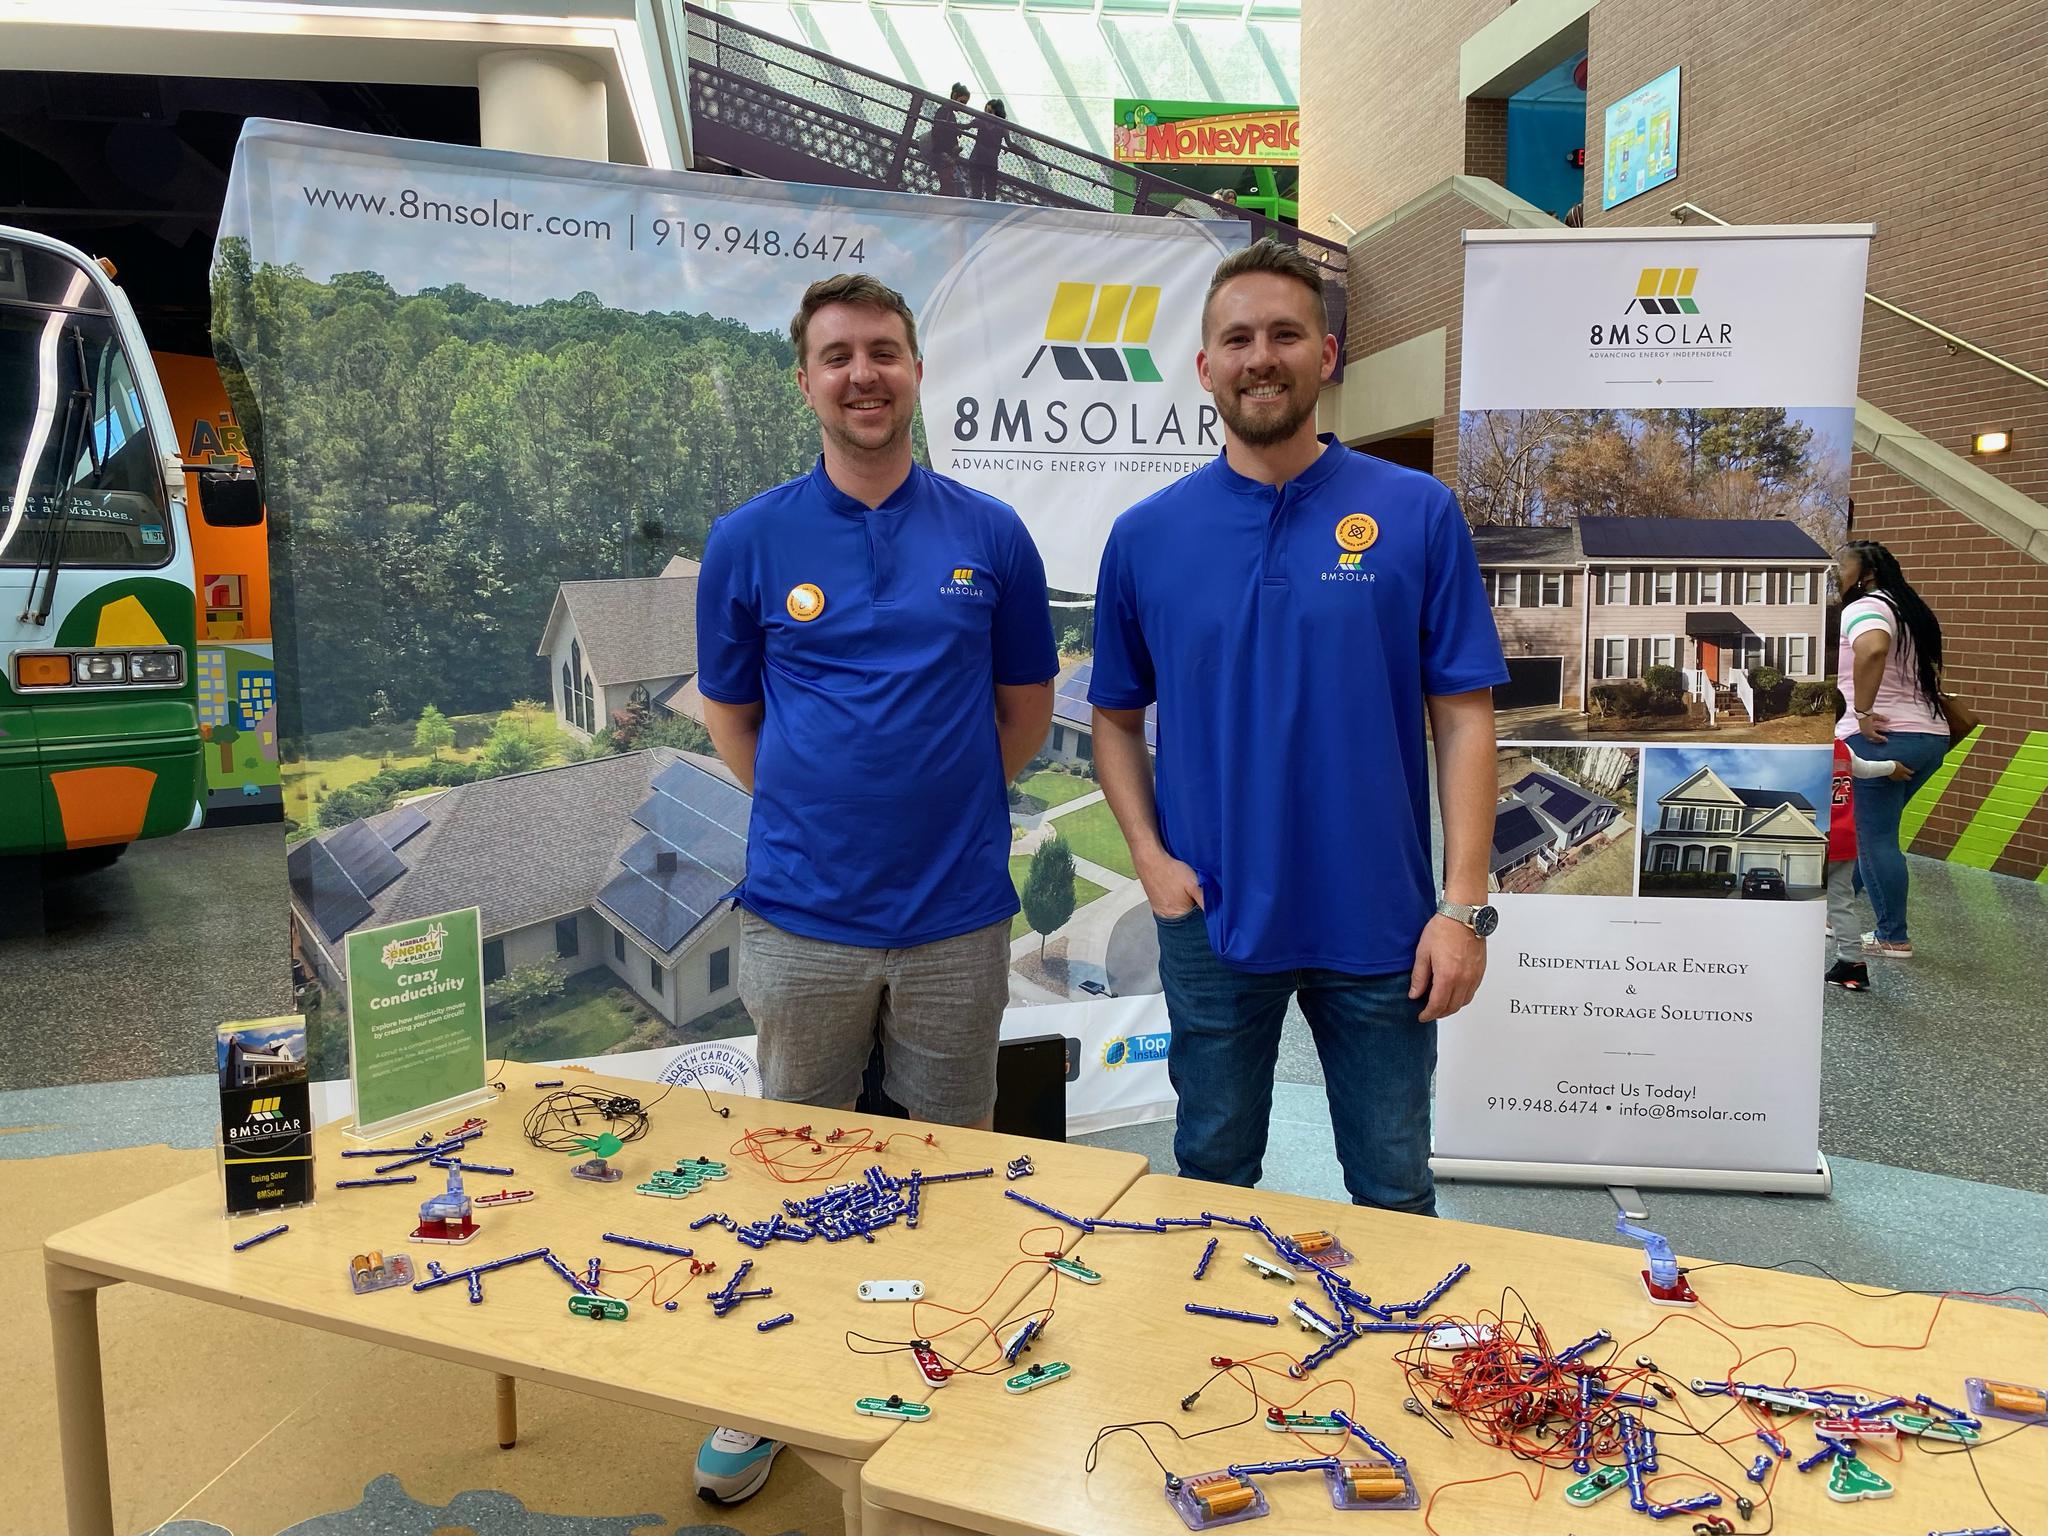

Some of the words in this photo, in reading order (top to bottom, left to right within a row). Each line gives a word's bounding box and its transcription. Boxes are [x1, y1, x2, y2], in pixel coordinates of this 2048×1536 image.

[303, 186, 611, 240] www.8msolar.com
[652, 218, 865, 264] 919.948.6474
[1589, 323, 1732, 345] 8MSOLAR
[954, 396, 1218, 446] 8MSOLAR
[951, 458, 1043, 471] ADVANCING
[1051, 460, 1106, 473] ENERGY
[1321, 572, 1376, 582] 8MSOLAR
[940, 586, 984, 598] 8MSOLAR
[397, 968, 438, 987] Crazy
[370, 977, 465, 1010] Conductivity
[1625, 984, 1637, 995] &
[371, 1020, 398, 1033] Explore
[398, 1017, 412, 1026] how
[414, 1007, 445, 1021] electricity
[446, 1002, 466, 1012] moves
[374, 1031, 383, 1040] by
[384, 1024, 412, 1037] creating
[413, 1019, 427, 1030] your
[428, 1016, 443, 1025] own
[1135, 1036, 1166, 1053] Top
[665, 1055, 698, 1085] NORTH
[701, 1050, 750, 1076] CAROLINA
[1557, 1080, 1615, 1096] Contact
[1620, 1083, 1640, 1097] Us
[1645, 1084, 1696, 1102] Today!
[1487, 1096, 1598, 1114] 919.948.6474
[1619, 1102, 1767, 1122] info@8msolar.com
[230, 1119, 301, 1138] 8MSOLAR
[270, 1171, 288, 1180] Solar
[256, 1188, 284, 1200] 8MSolar
